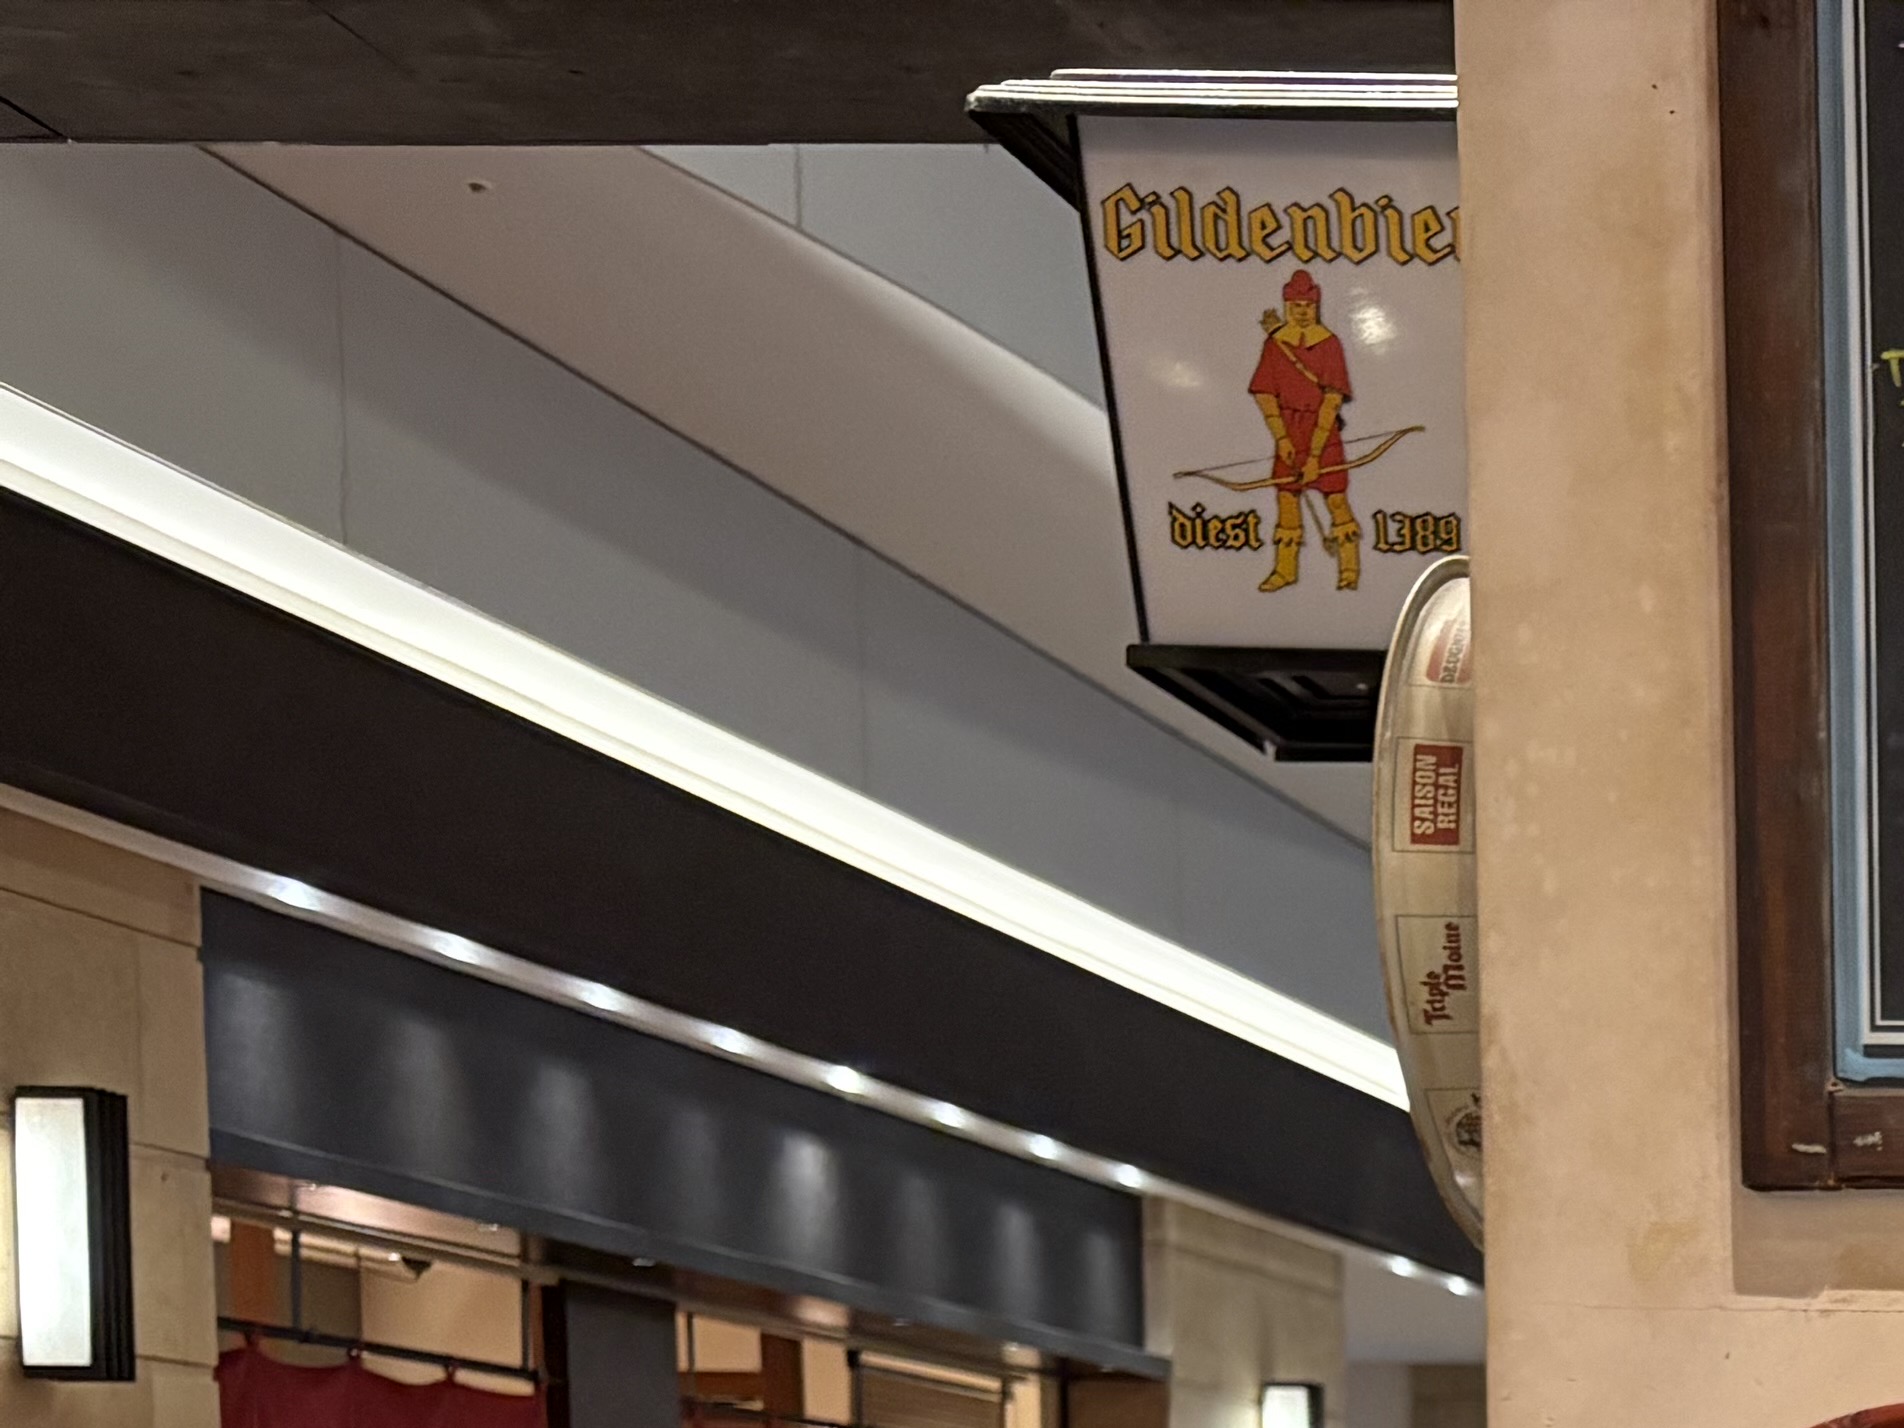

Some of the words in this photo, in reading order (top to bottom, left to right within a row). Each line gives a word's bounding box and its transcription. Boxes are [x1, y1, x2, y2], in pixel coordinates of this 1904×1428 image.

[1167, 501, 1265, 552] diest
[1372, 511, 1462, 554] 1389
[1412, 752, 1440, 838] SAISON
[1436, 763, 1461, 831] REGAL
